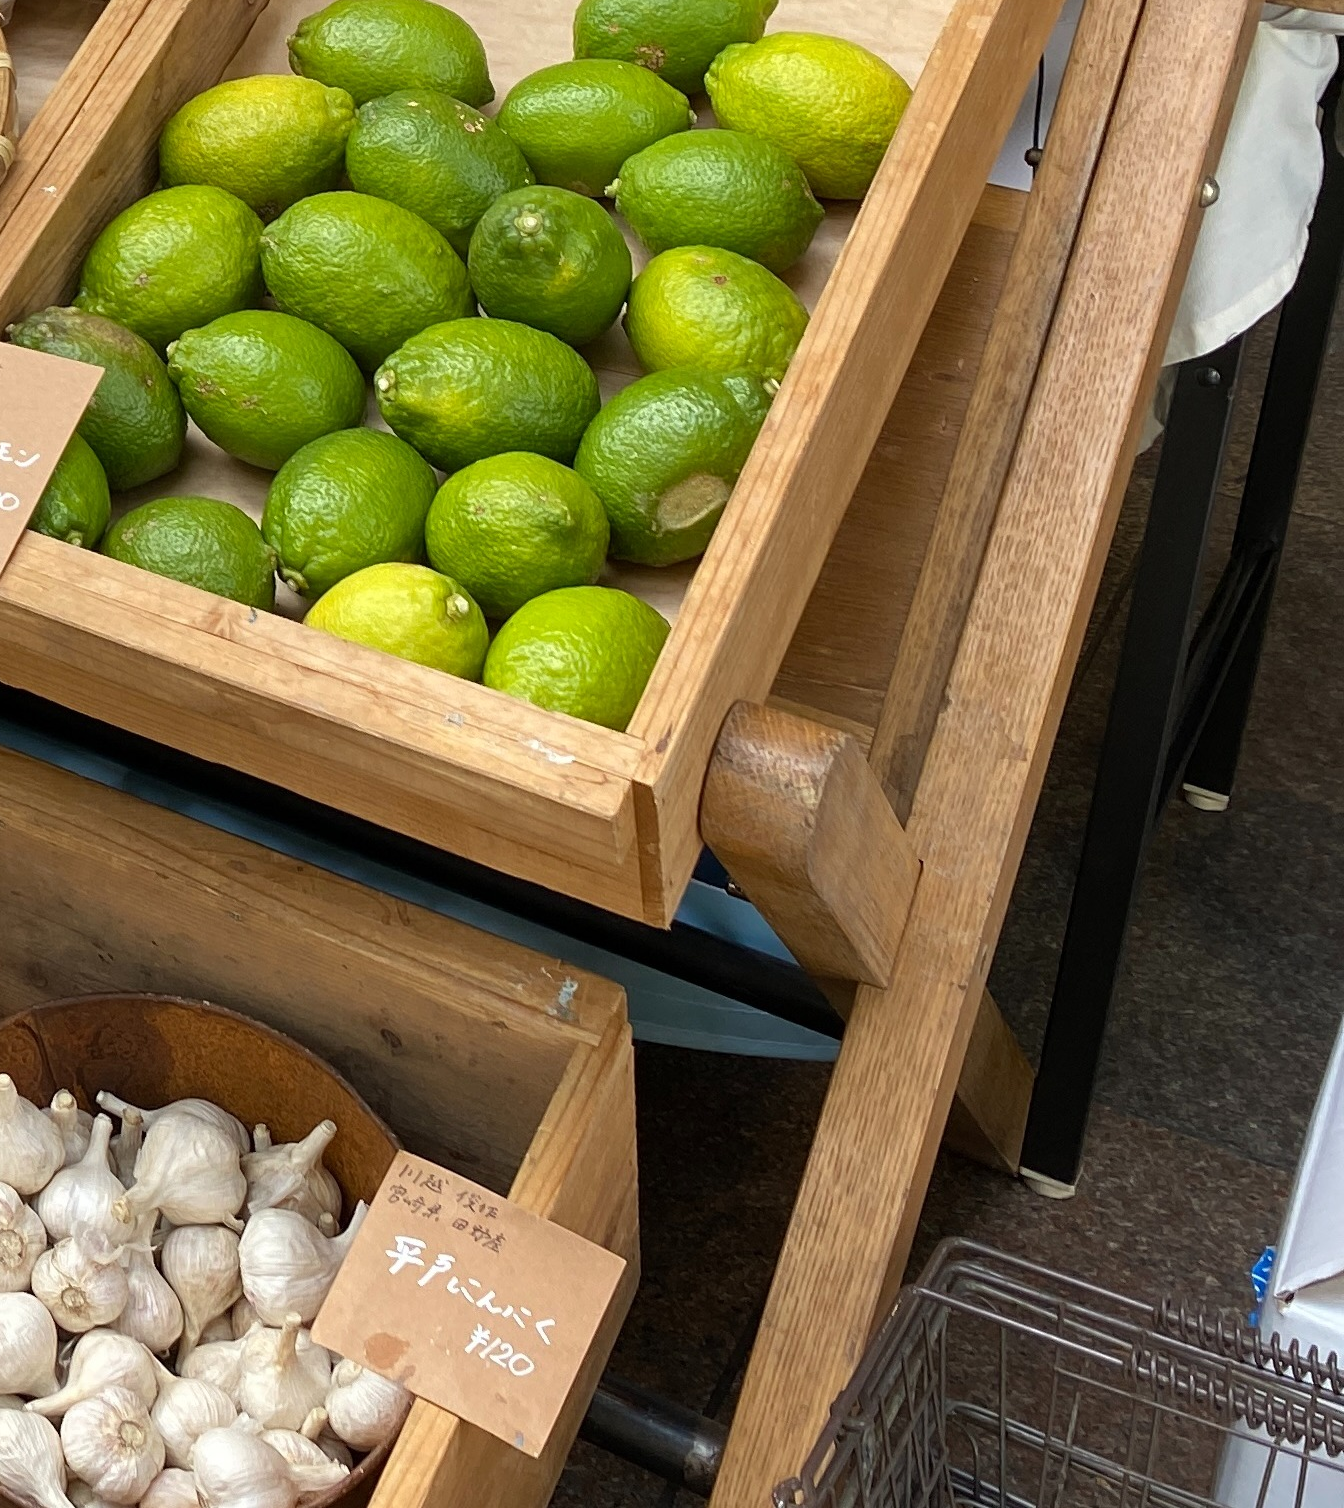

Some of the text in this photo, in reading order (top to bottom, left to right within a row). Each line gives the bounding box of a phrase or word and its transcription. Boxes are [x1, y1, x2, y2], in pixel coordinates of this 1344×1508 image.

[384, 1234, 558, 1347] 平戸にんにく
[464, 1322, 536, 1377] ¥120
